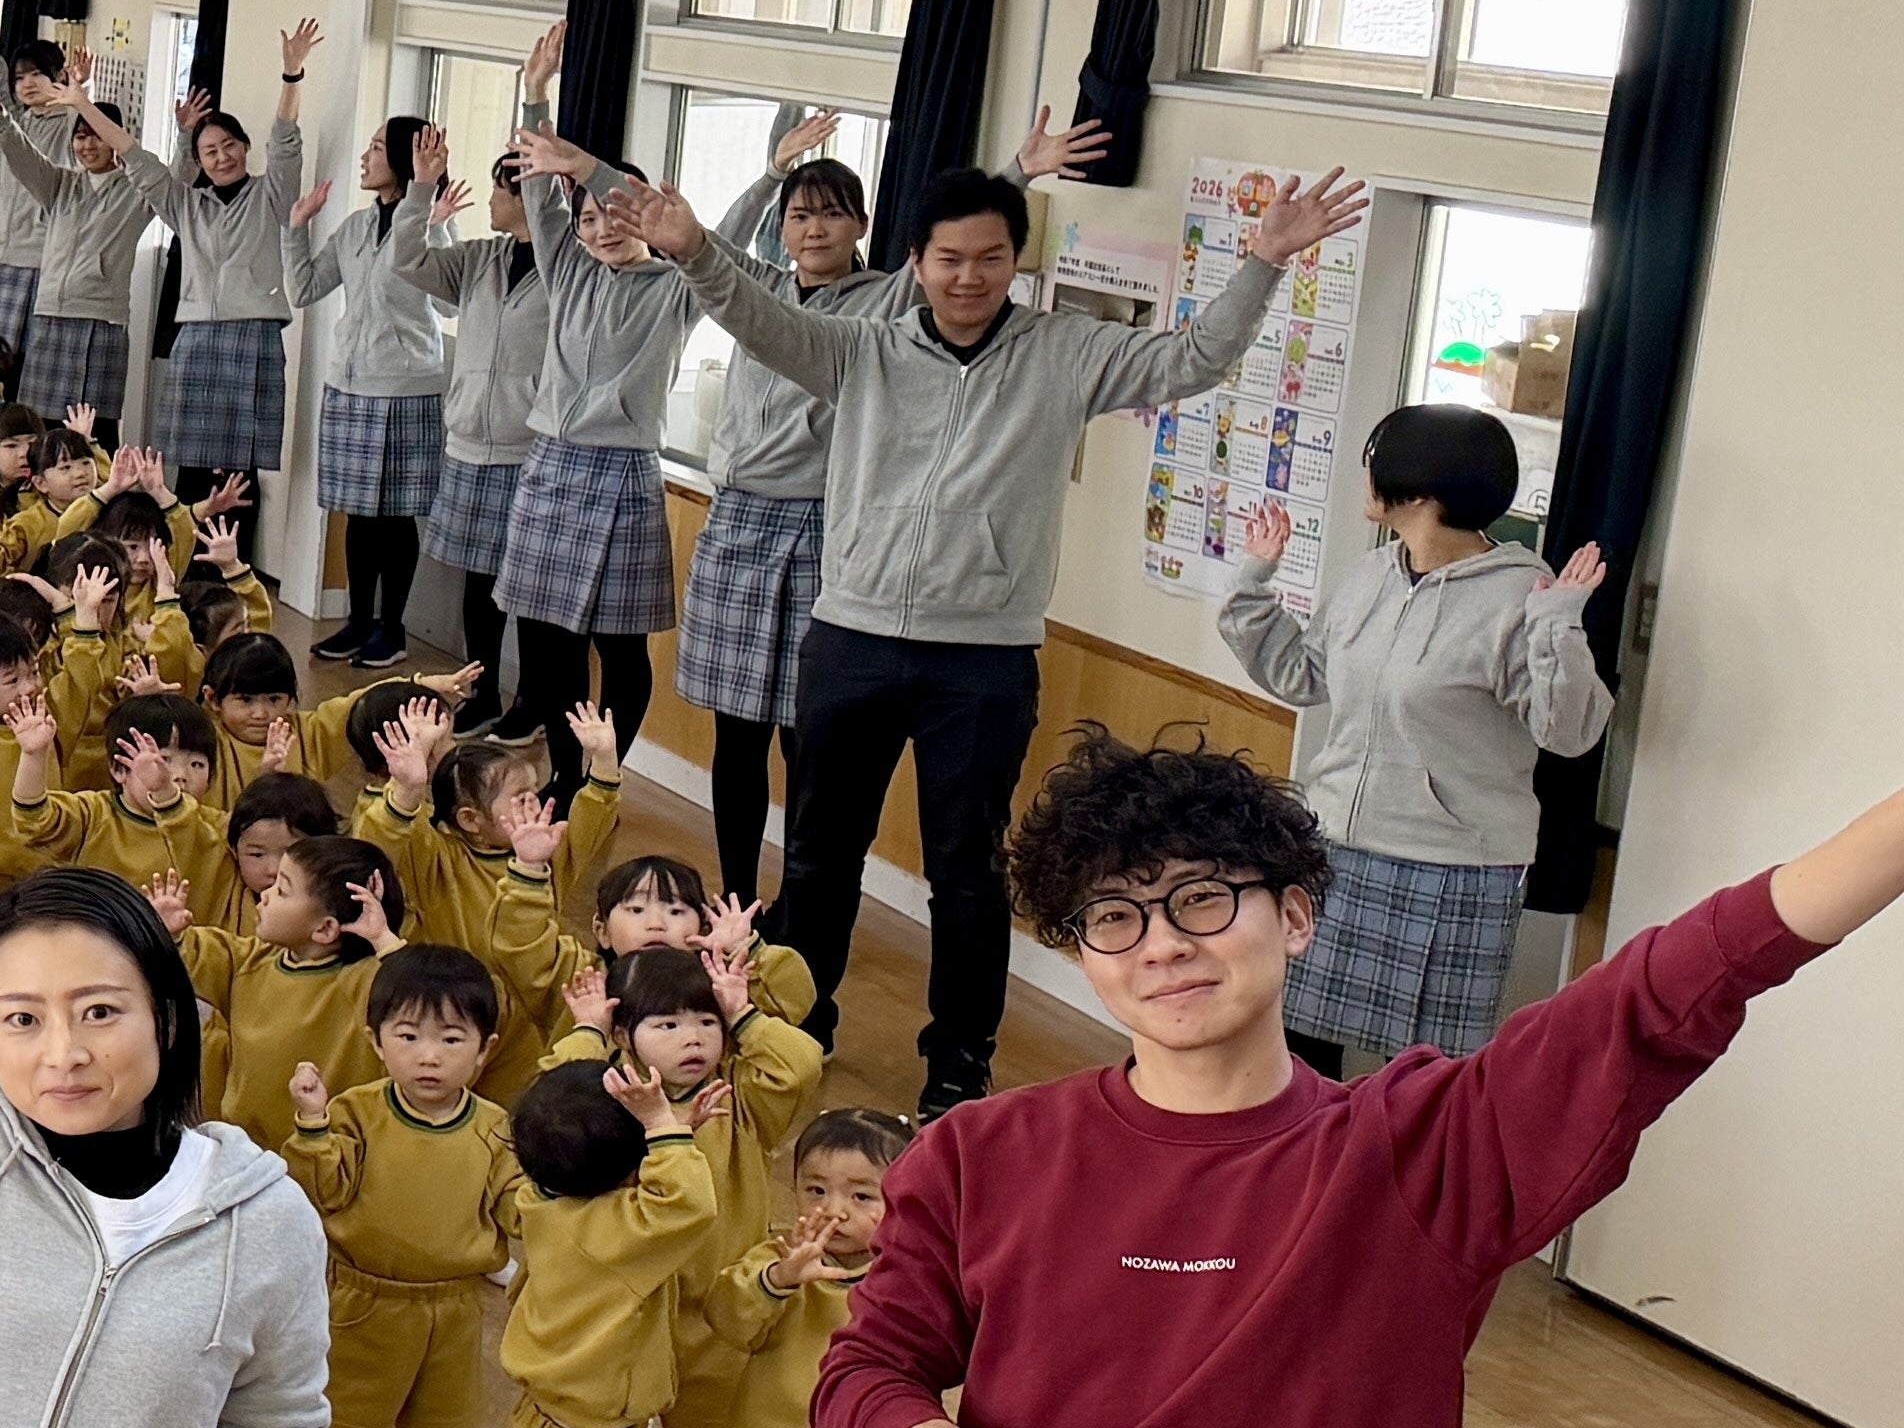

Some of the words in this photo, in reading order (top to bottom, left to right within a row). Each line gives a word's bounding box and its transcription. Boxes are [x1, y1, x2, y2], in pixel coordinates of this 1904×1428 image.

[1192, 176, 1223, 198] 2026
[1121, 1256, 1181, 1272] NOZAWA
[1182, 1258, 1236, 1272] MOKKOU
